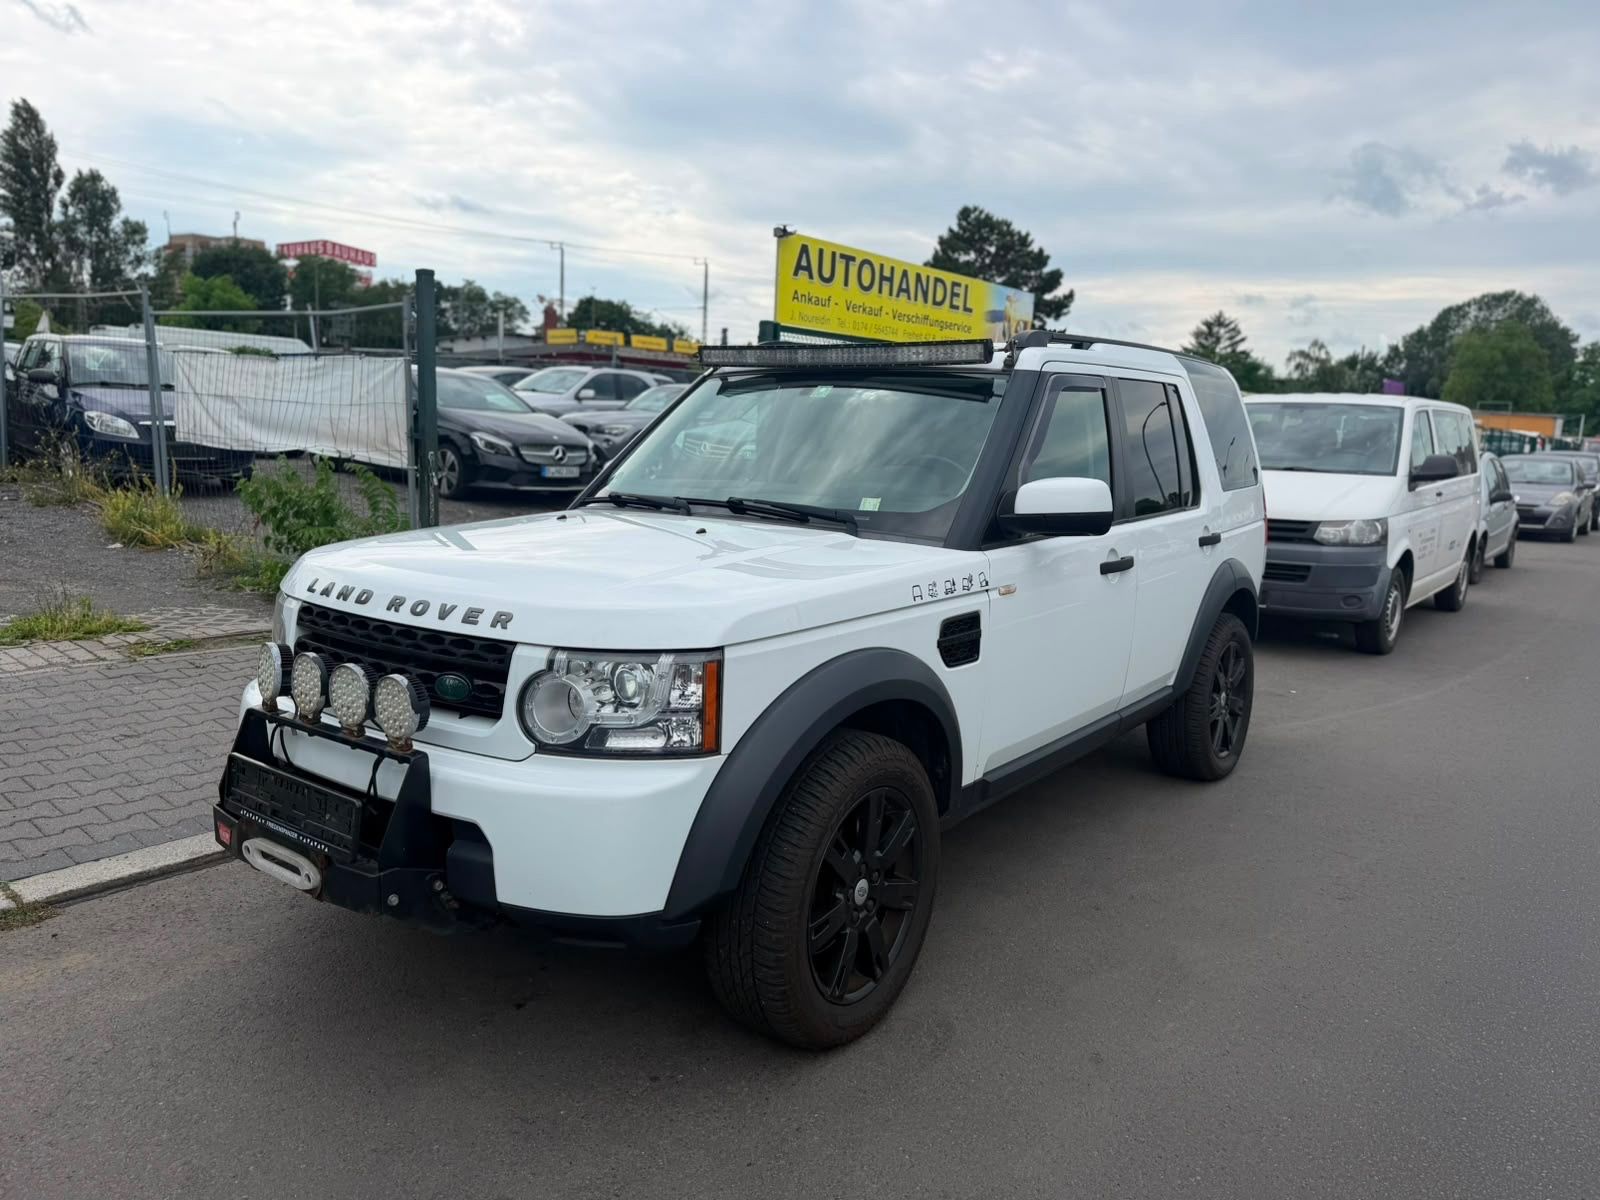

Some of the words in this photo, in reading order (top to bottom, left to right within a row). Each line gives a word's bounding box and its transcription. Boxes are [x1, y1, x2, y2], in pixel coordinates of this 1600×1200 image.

[792, 289, 832, 308] Ankauf
[845, 300, 883, 318] Verkauf
[793, 243, 973, 313] AUTOHANDEL
[307, 577, 374, 605] LAND
[386, 595, 513, 629] ROVER
